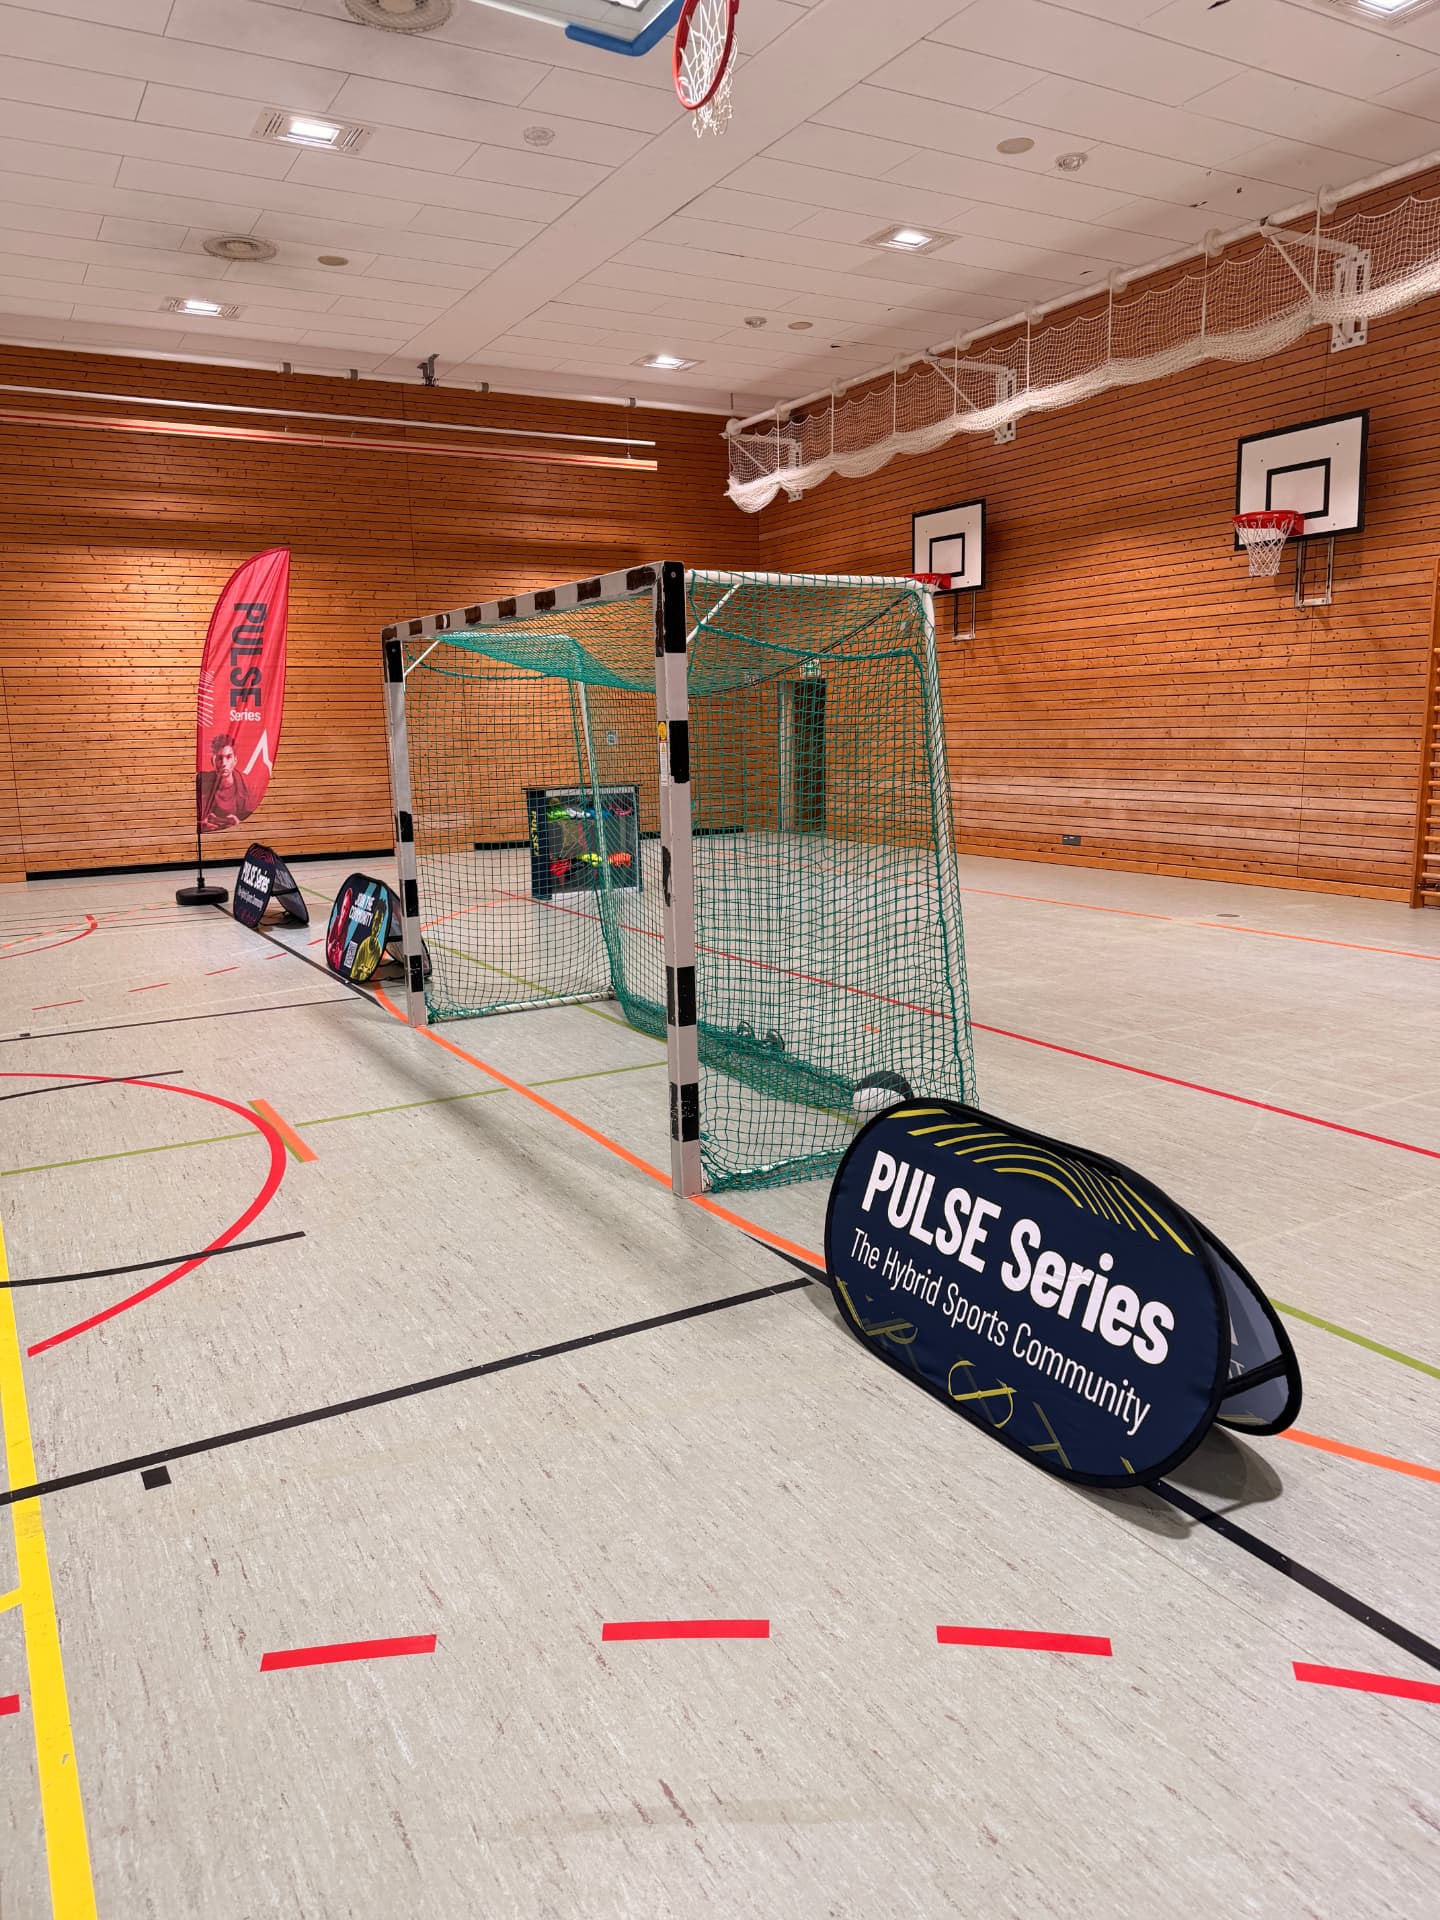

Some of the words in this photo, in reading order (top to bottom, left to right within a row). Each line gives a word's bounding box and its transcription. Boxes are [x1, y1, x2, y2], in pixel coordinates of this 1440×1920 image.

[230, 603, 267, 707] PULSE
[230, 709, 261, 722] Series
[241, 861, 258, 887] PULSE
[254, 868, 271, 894] Series
[861, 1150, 1002, 1273] PULSE
[1000, 1218, 1175, 1365] Series
[850, 1227, 880, 1272] The
[881, 1252, 942, 1307] Hybrid
[942, 1284, 1009, 1346] Sports
[1012, 1325, 1152, 1436] Community
